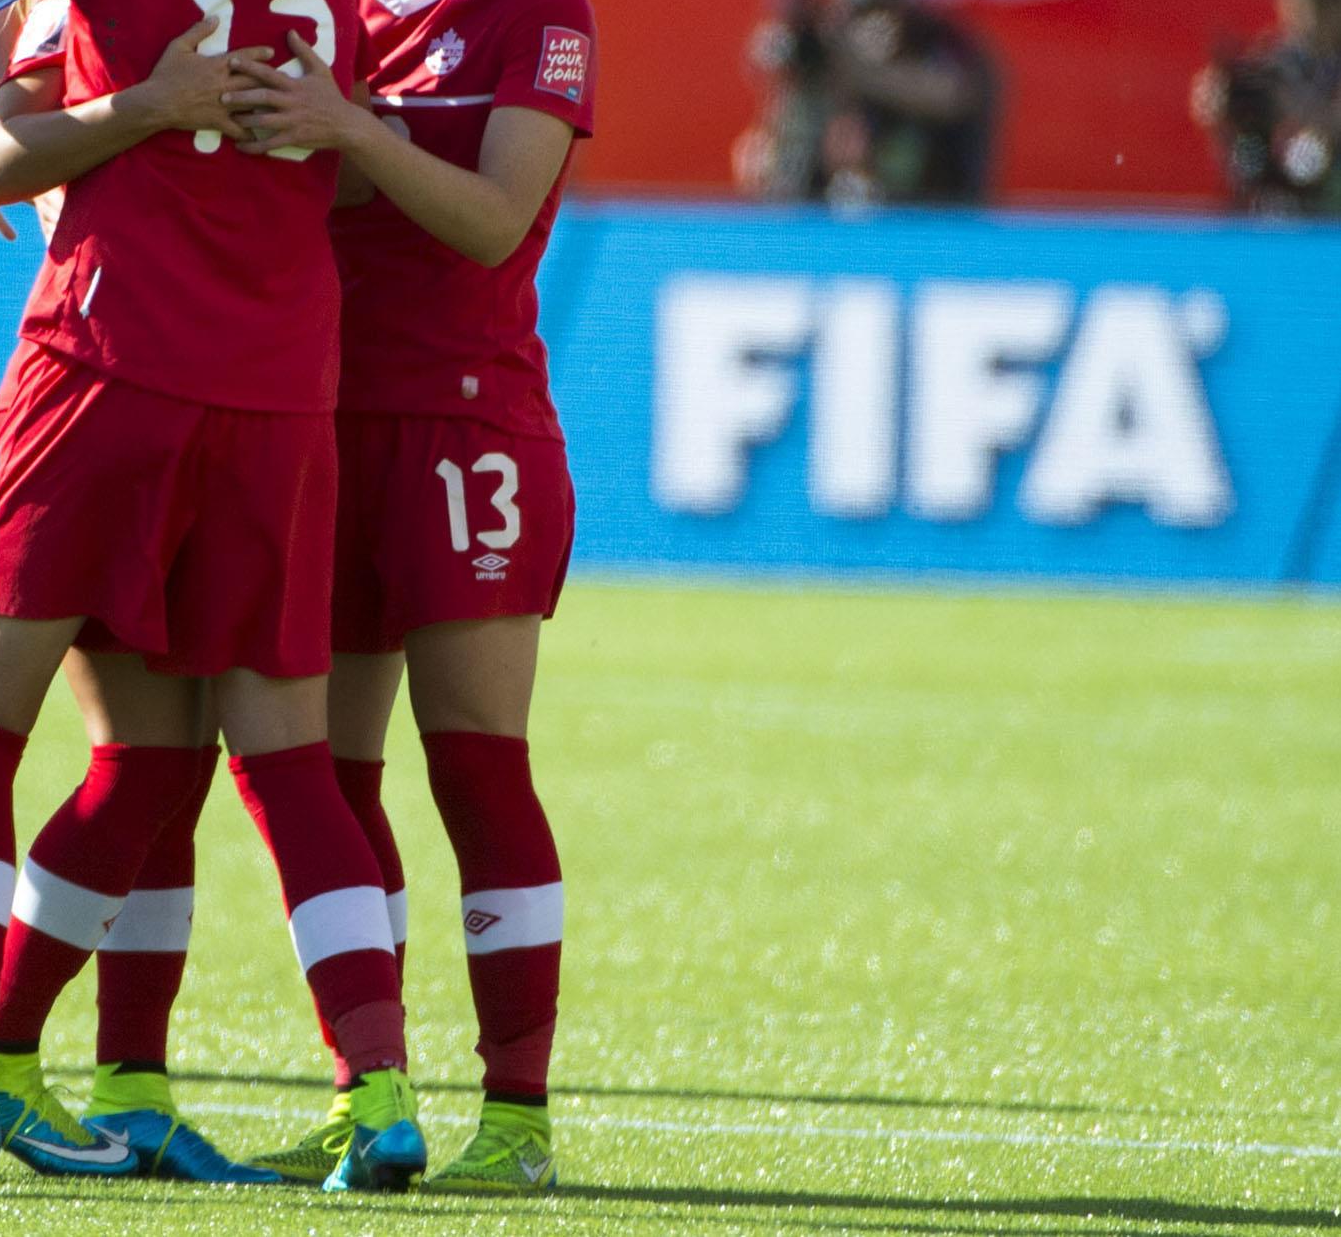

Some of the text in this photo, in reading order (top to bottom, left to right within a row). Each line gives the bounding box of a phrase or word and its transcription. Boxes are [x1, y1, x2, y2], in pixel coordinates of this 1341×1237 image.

[549, 38, 580, 51] LIVE
[547, 53, 583, 67] YOUR
[542, 68, 583, 84] GOALS
[435, 453, 521, 552] 13
